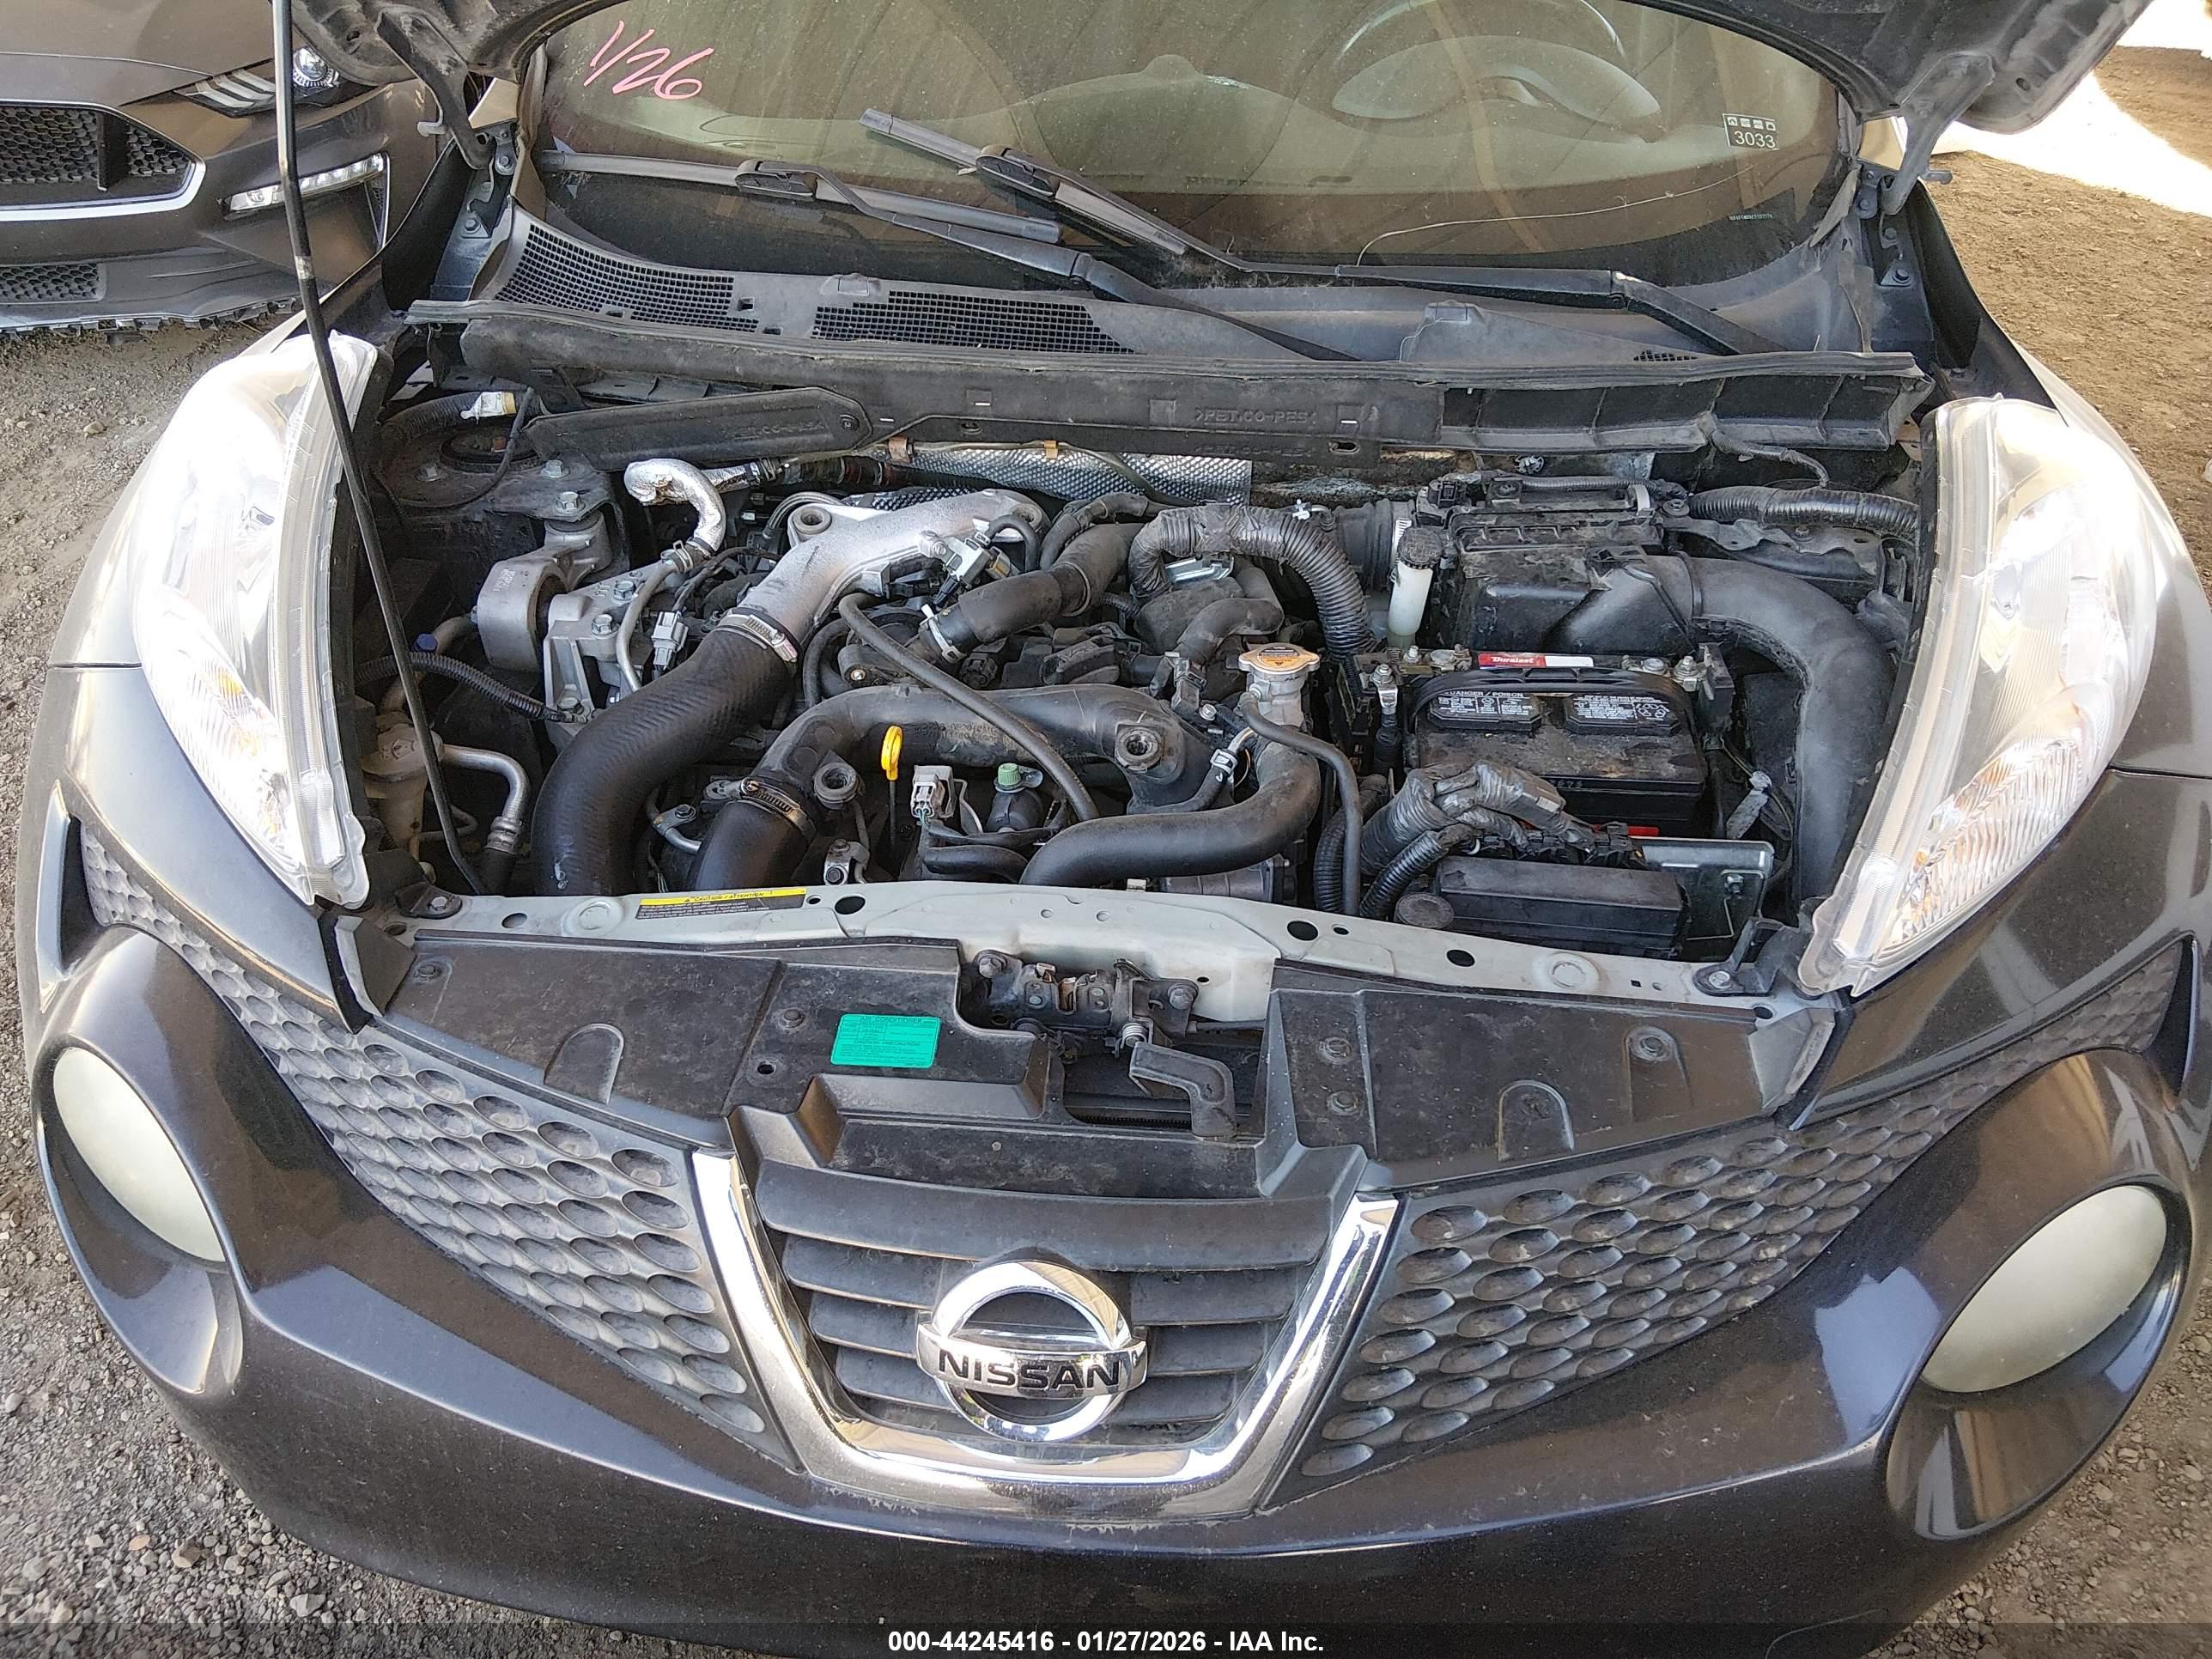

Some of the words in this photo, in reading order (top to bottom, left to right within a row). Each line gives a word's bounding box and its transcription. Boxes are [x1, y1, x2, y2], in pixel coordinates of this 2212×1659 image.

[583, 20, 714, 100] 1/26
[1734, 131, 1776, 149] 3033
[938, 1348, 1122, 1391] NISSAN
